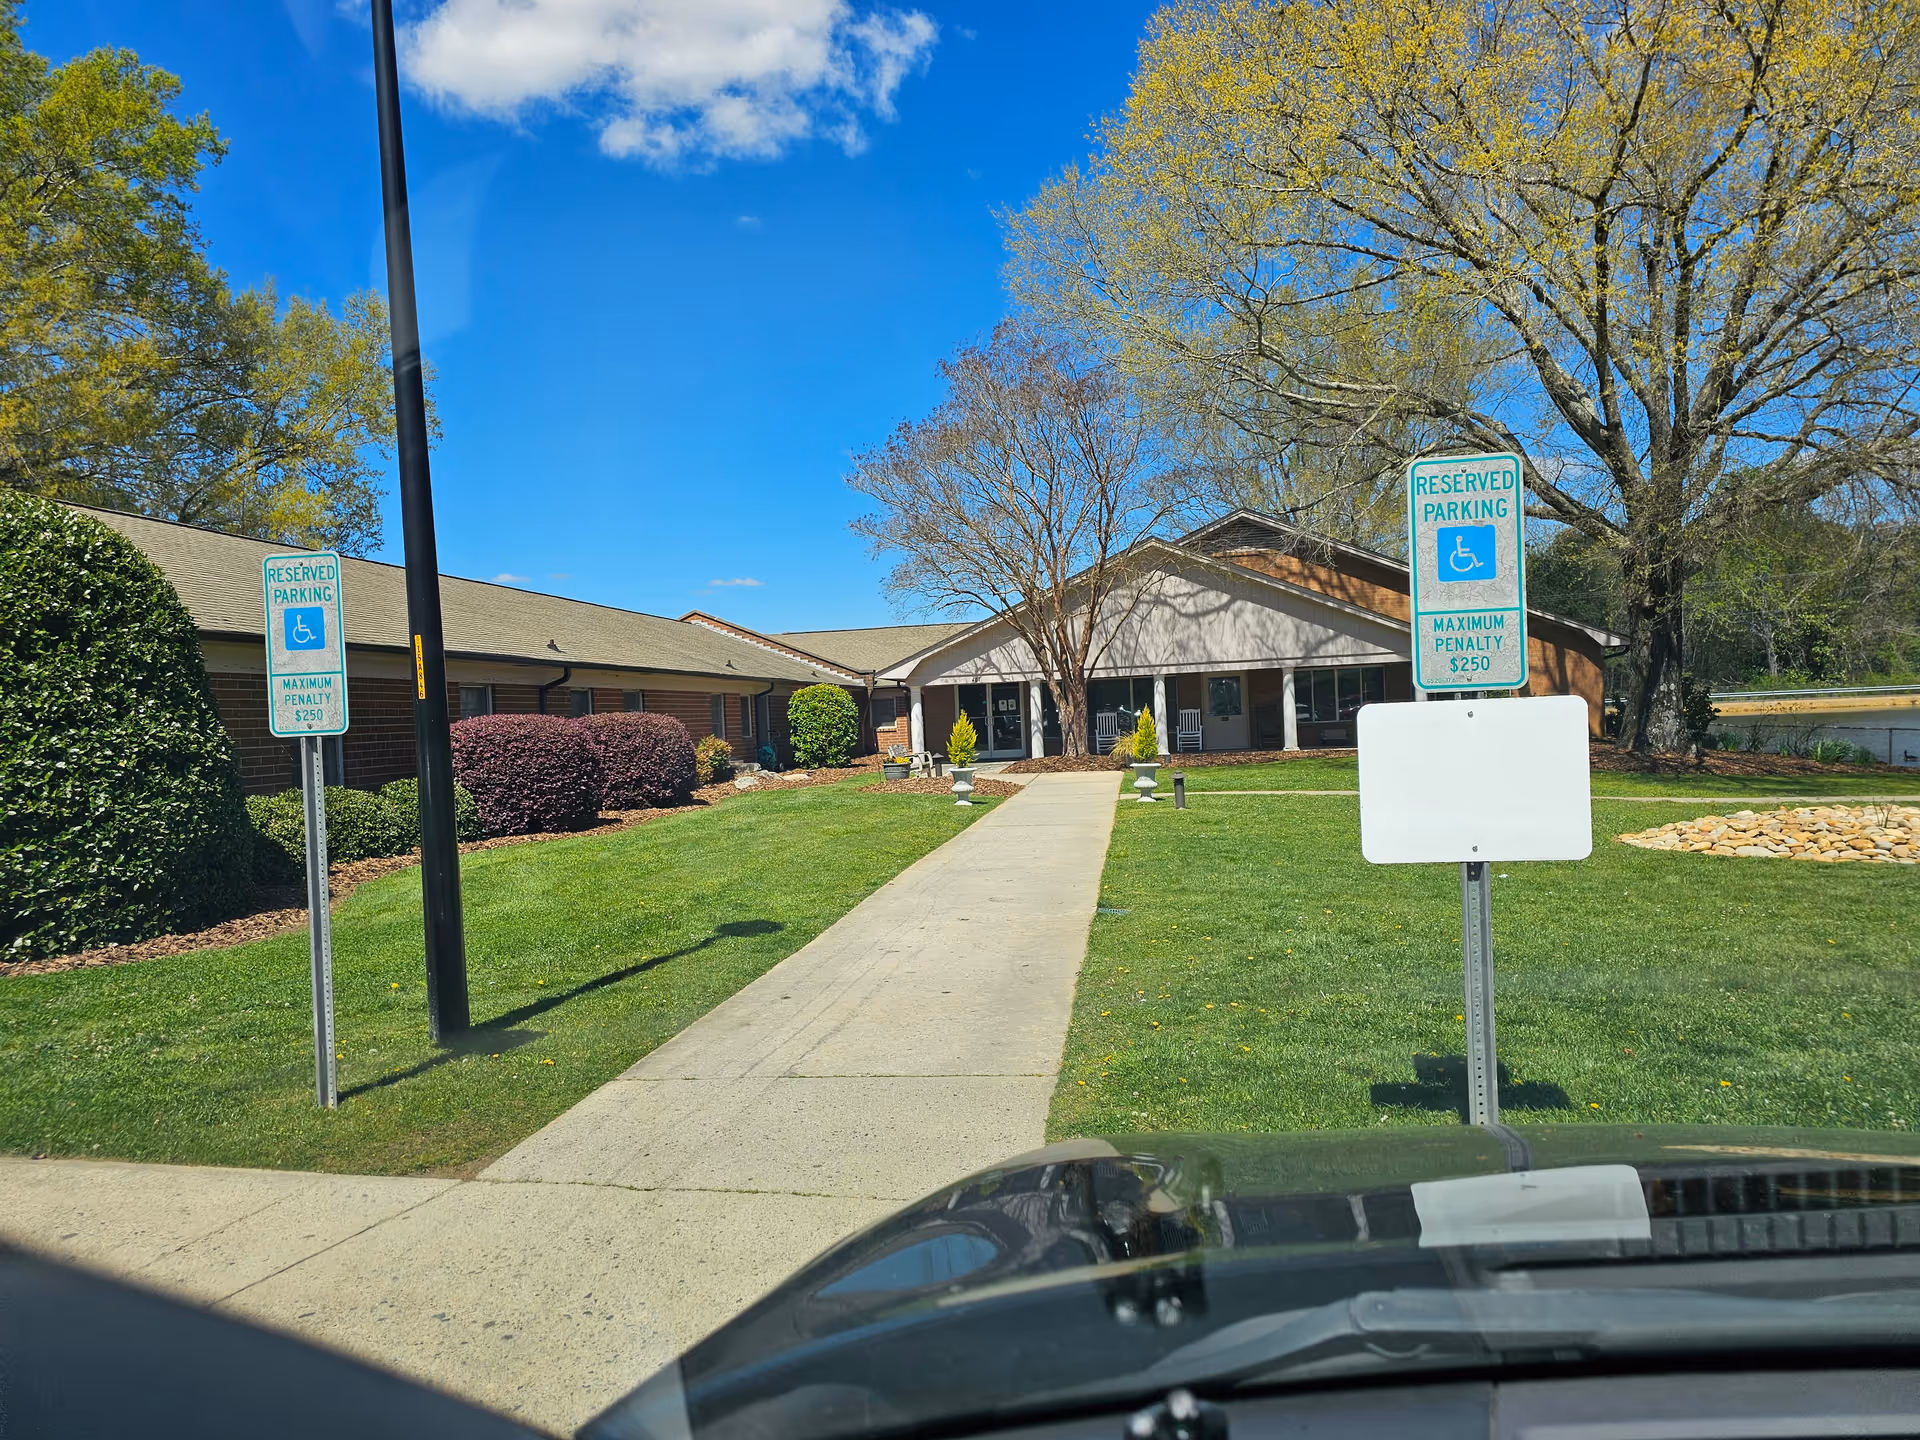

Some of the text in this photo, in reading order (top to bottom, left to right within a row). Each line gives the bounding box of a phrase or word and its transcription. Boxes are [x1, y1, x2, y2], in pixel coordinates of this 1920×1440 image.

[1416, 470, 1515, 496] RESERVED
[1424, 498, 1508, 522] PARKING
[268, 565, 335, 583] RESERVED
[274, 586, 332, 604] PARKING
[1433, 615, 1505, 632] MAXIMUM
[1435, 636, 1503, 652] PENALTY
[1450, 656, 1490, 673] $250
[282, 677, 332, 690] MAXIMUM
[284, 693, 331, 706] PENALTY
[295, 709, 323, 722] $250
